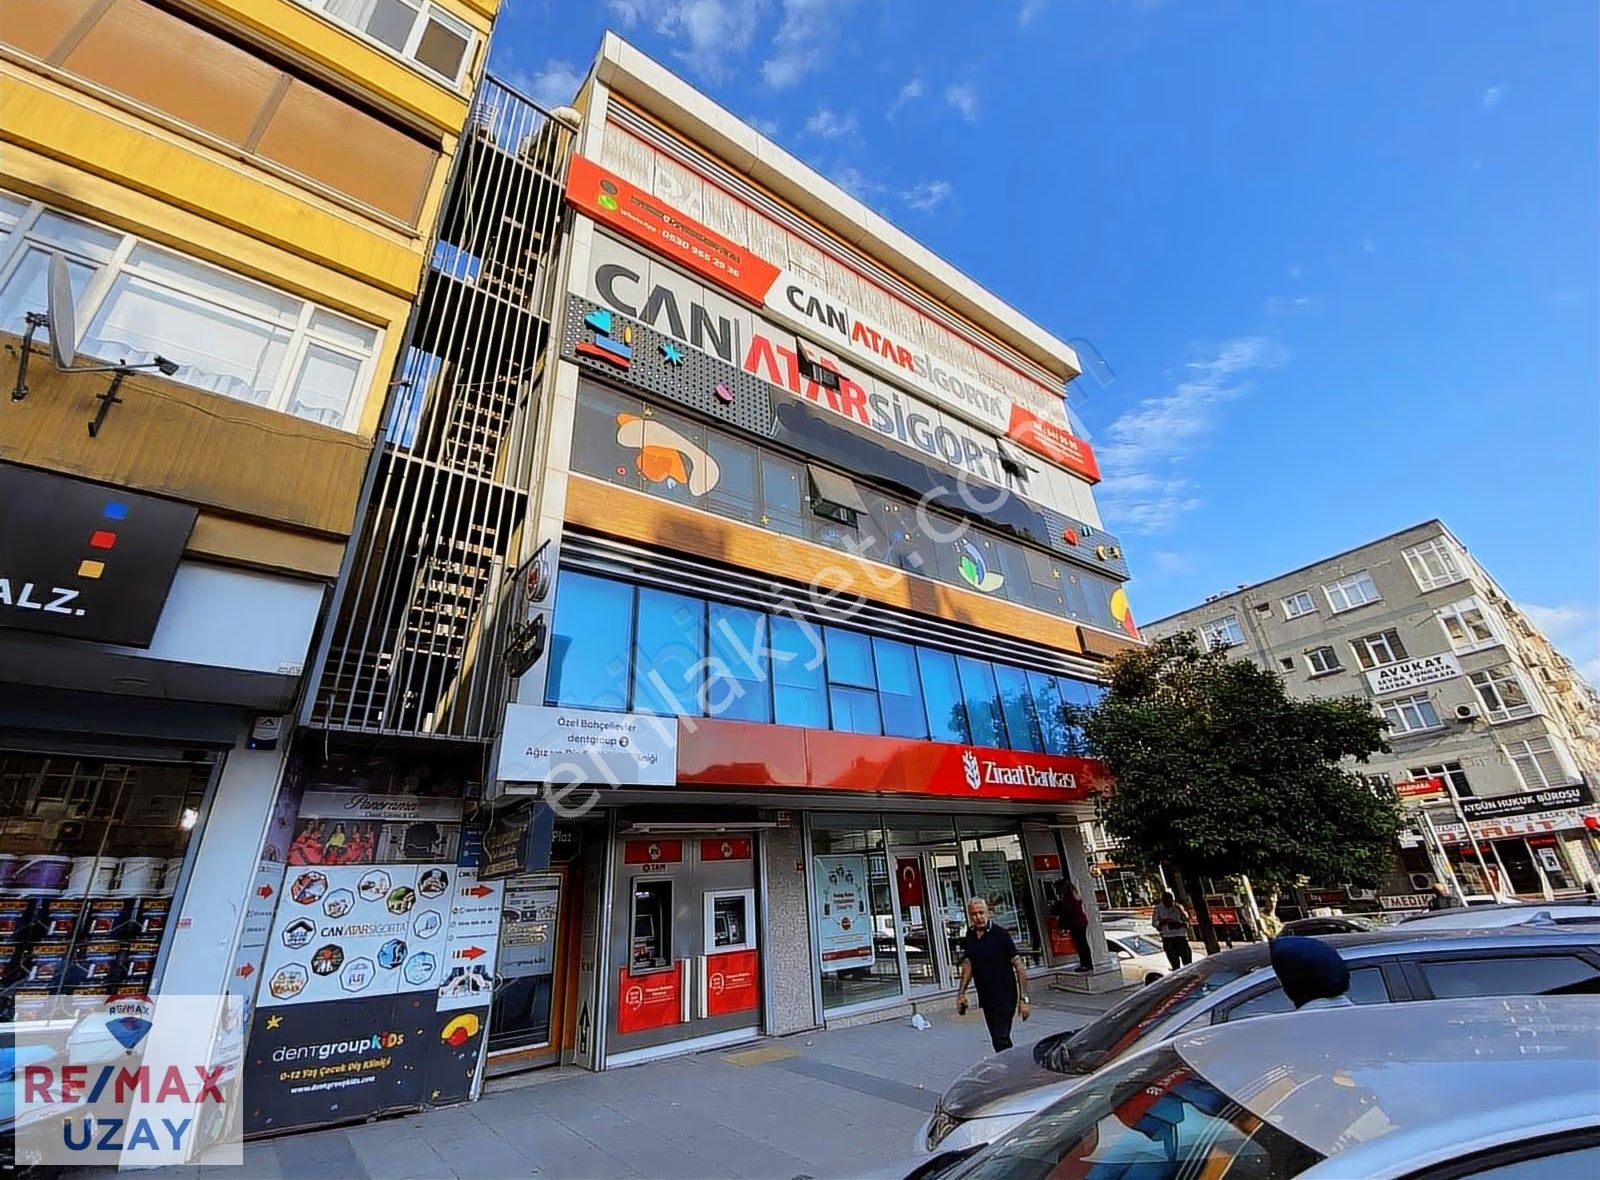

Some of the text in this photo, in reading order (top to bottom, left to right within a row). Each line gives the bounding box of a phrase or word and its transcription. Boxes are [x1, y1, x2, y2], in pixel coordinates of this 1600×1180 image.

[595, 263, 732, 363] CAN
[786, 285, 846, 335] CAN
[1380, 656, 1443, 679] AVUKAT
[557, 716, 579, 727] Özel
[525, 747, 549, 759] Ağız
[982, 760, 1077, 789] Ziraat Bankası
[1497, 795, 1536, 808] HUKUK
[1536, 788, 1581, 803] BÜROSU
[320, 926, 344, 937] CAN
[279, 1070, 301, 1081] 0-12
[319, 1063, 346, 1077] Çocuk
